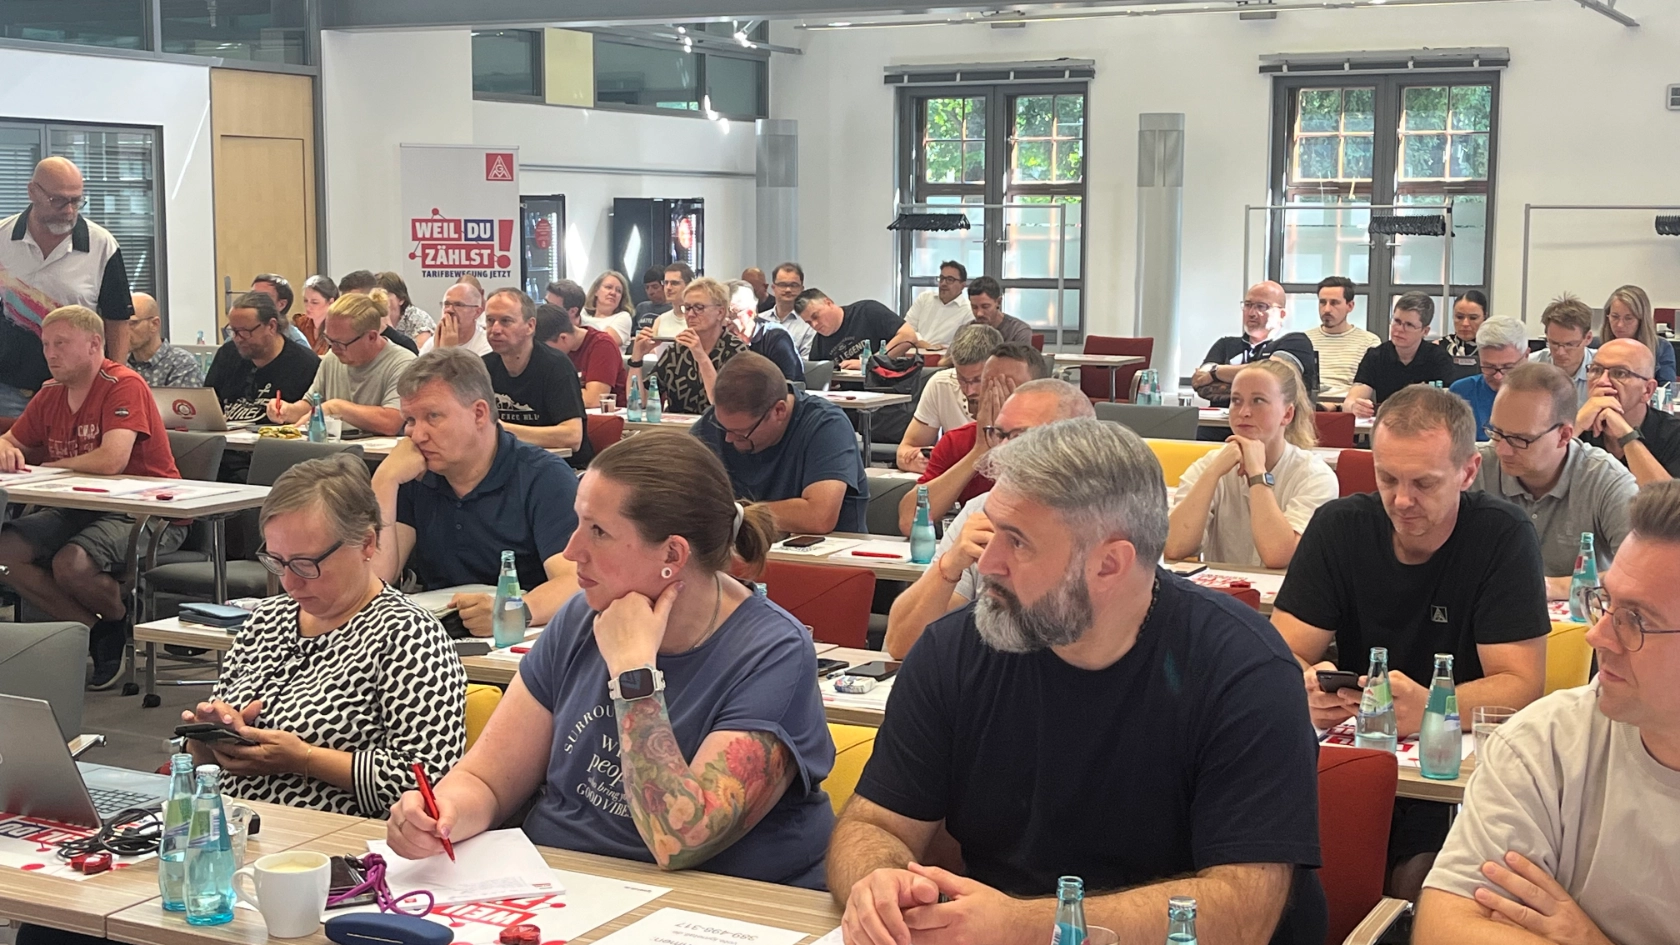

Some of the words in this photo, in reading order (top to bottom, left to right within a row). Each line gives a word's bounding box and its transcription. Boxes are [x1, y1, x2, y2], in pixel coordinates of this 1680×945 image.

[415, 222, 459, 239] WEIL
[467, 222, 491, 239] DU
[425, 245, 491, 265] ZÄHLST
[422, 270, 488, 278] TARIFBEWEGUNG
[489, 271, 511, 279] JETZT
[564, 704, 615, 754] SURROU
[576, 782, 603, 807] GOOD
